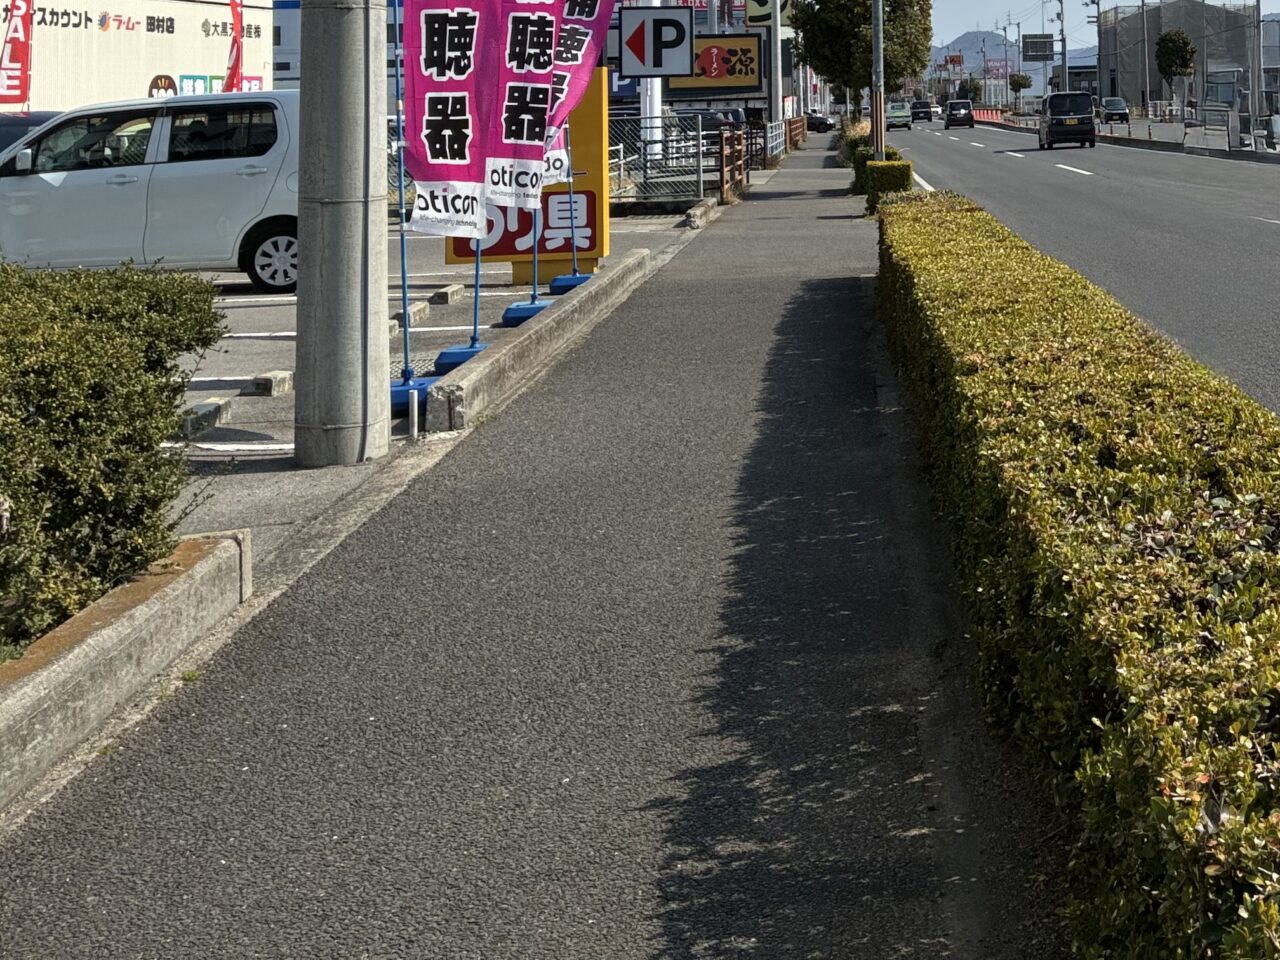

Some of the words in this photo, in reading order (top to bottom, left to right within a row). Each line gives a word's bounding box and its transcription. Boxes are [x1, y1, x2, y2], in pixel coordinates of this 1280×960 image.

[146, 15, 175, 35] 田村店
[653, 18, 686, 68] P
[417, 187, 479, 215] oticon
